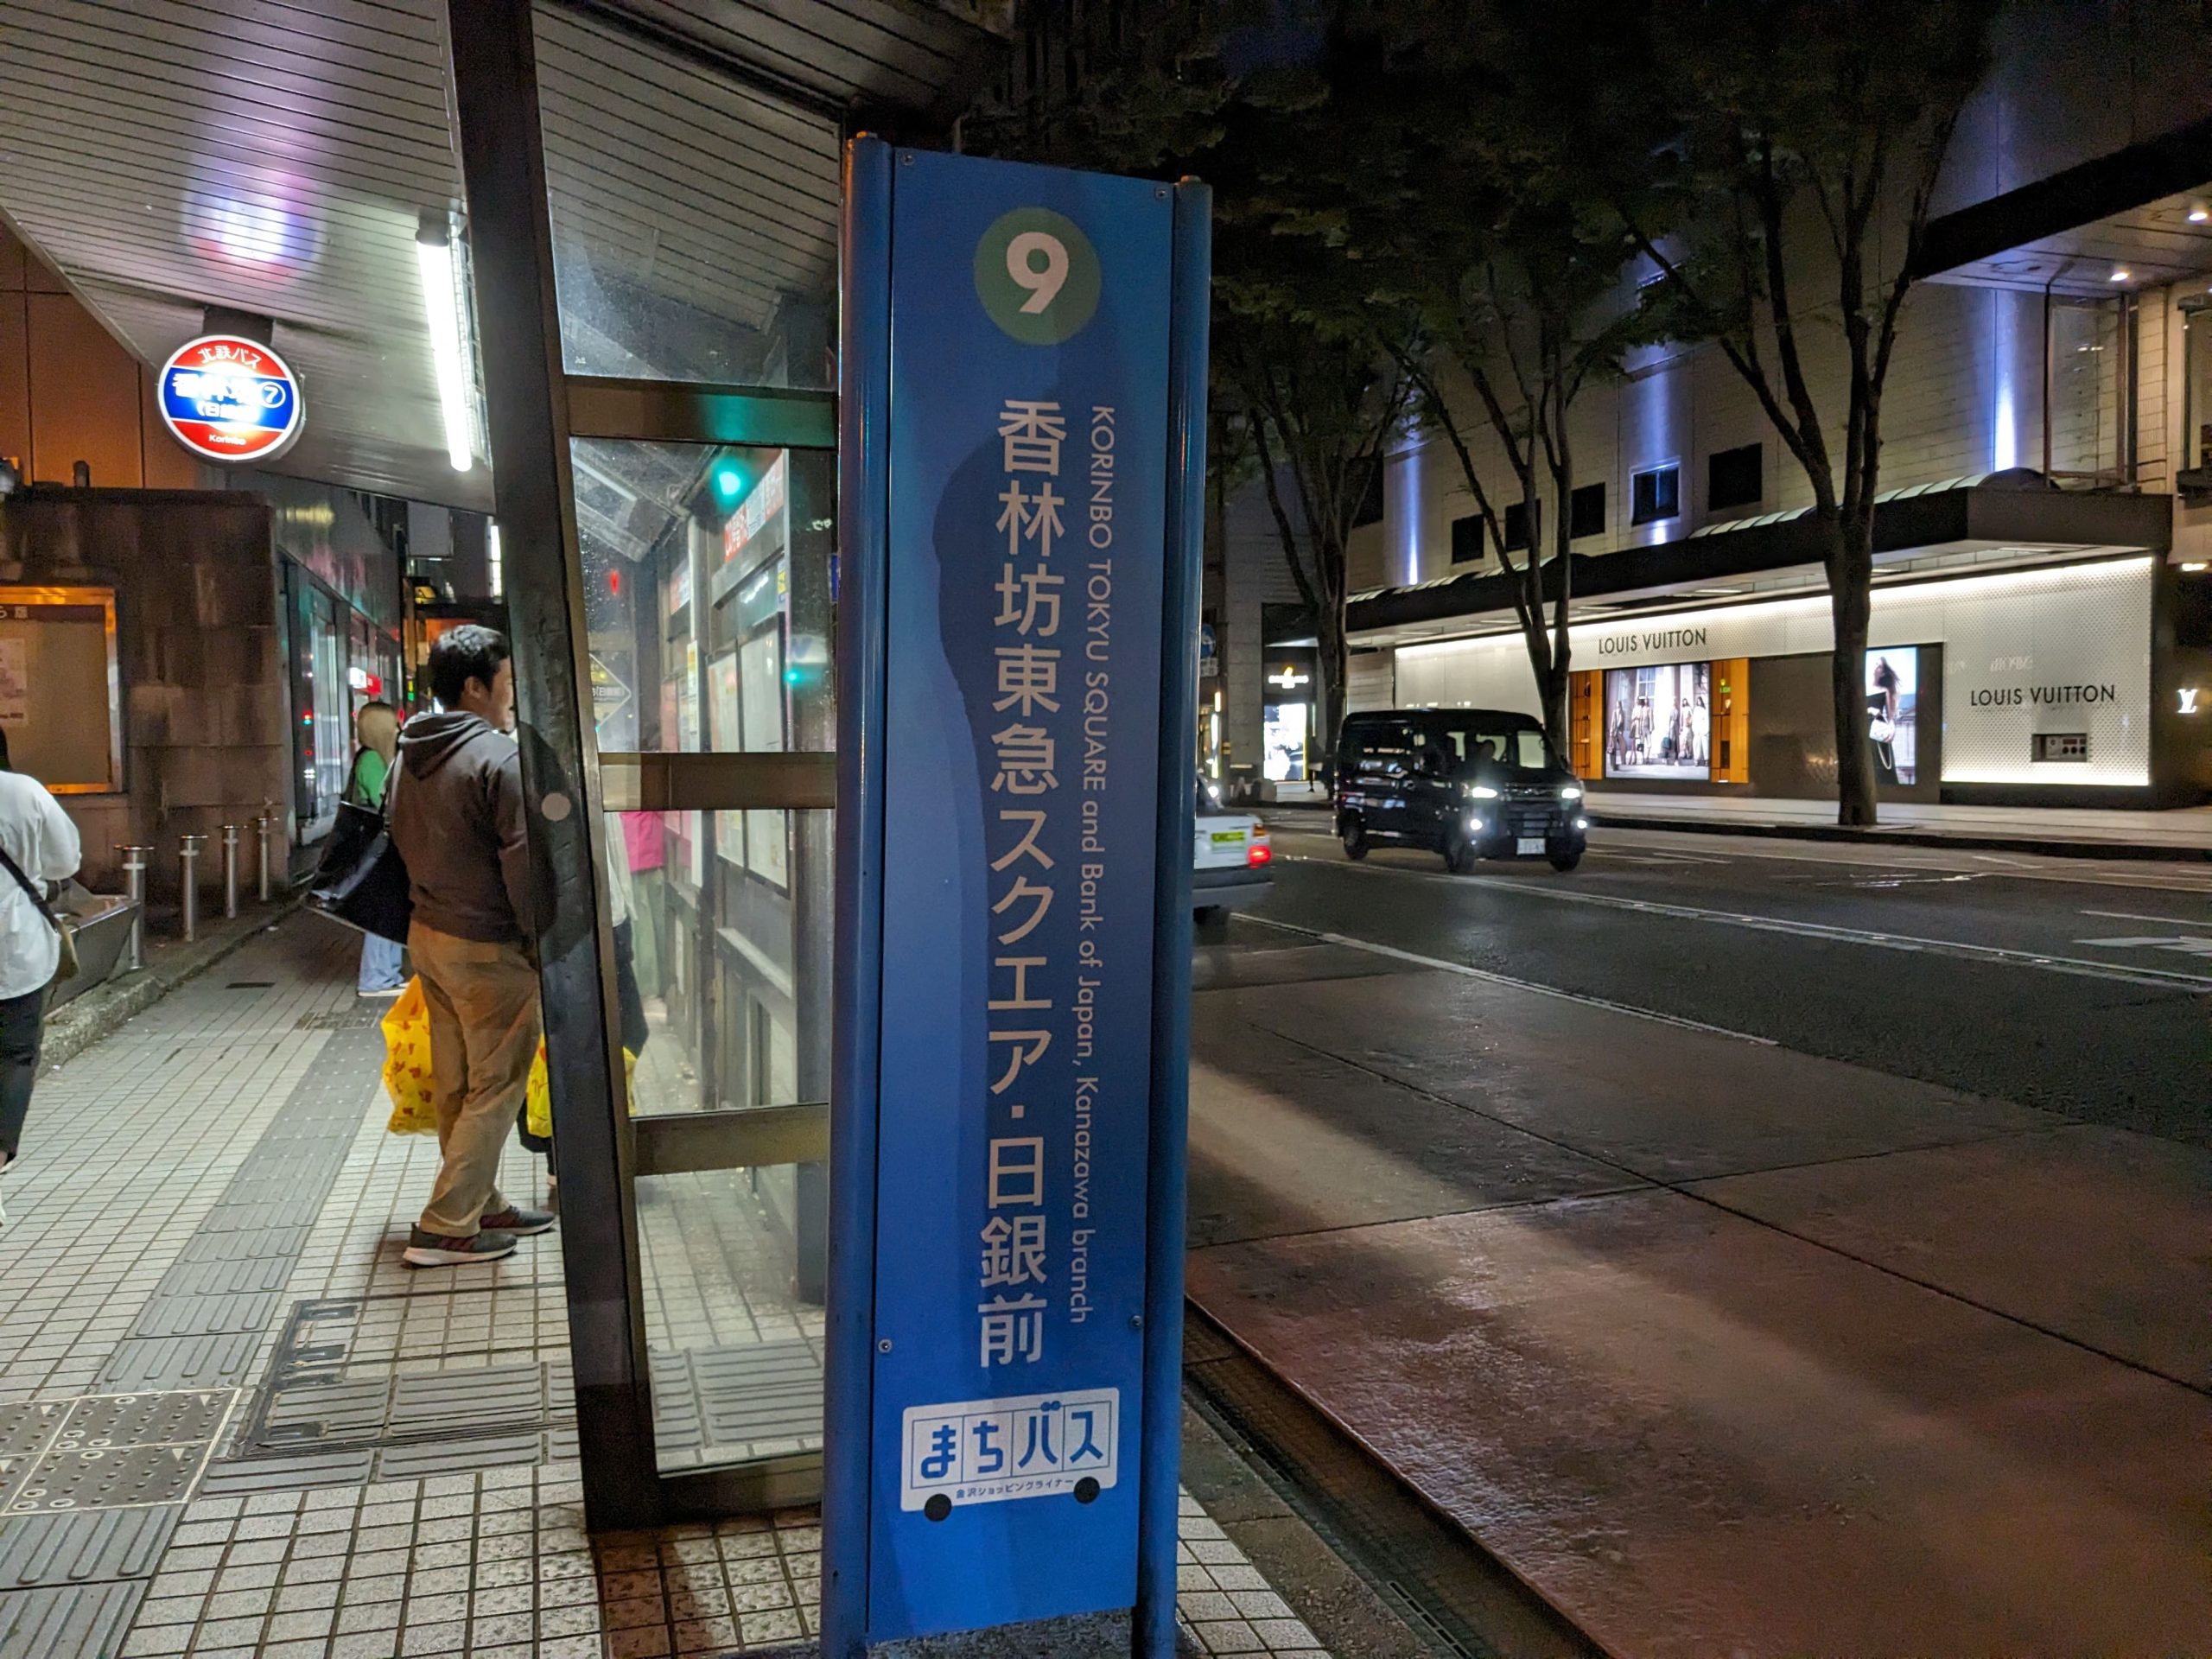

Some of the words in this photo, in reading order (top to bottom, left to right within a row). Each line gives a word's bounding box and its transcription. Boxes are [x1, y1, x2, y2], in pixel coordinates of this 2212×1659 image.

[1006, 232, 1070, 315] 9
[1089, 406, 1115, 549] KORINBO
[1085, 558, 1111, 661] TOKYU
[1599, 634, 1637, 654] LOUIS
[1642, 627, 1707, 651] VUITTON
[1083, 671, 1109, 791] SQUARE
[1971, 688, 2023, 707] LOUIS
[2030, 684, 2115, 704] VUITTON
[1081, 800, 1105, 852] and
[977, 399, 1068, 1368] 香林坊東急スクエア・日銀前
[1080, 864, 1104, 931] Bank
[1078, 940, 1103, 968] of
[1071, 976, 1101, 1066] Japan,
[1072, 1077, 1098, 1219] Kanazawa
[1070, 1229, 1096, 1323] branch
[920, 1400, 1104, 1479] まちバス
[956, 1478, 1075, 1499] 金沢ショッピングライナー
